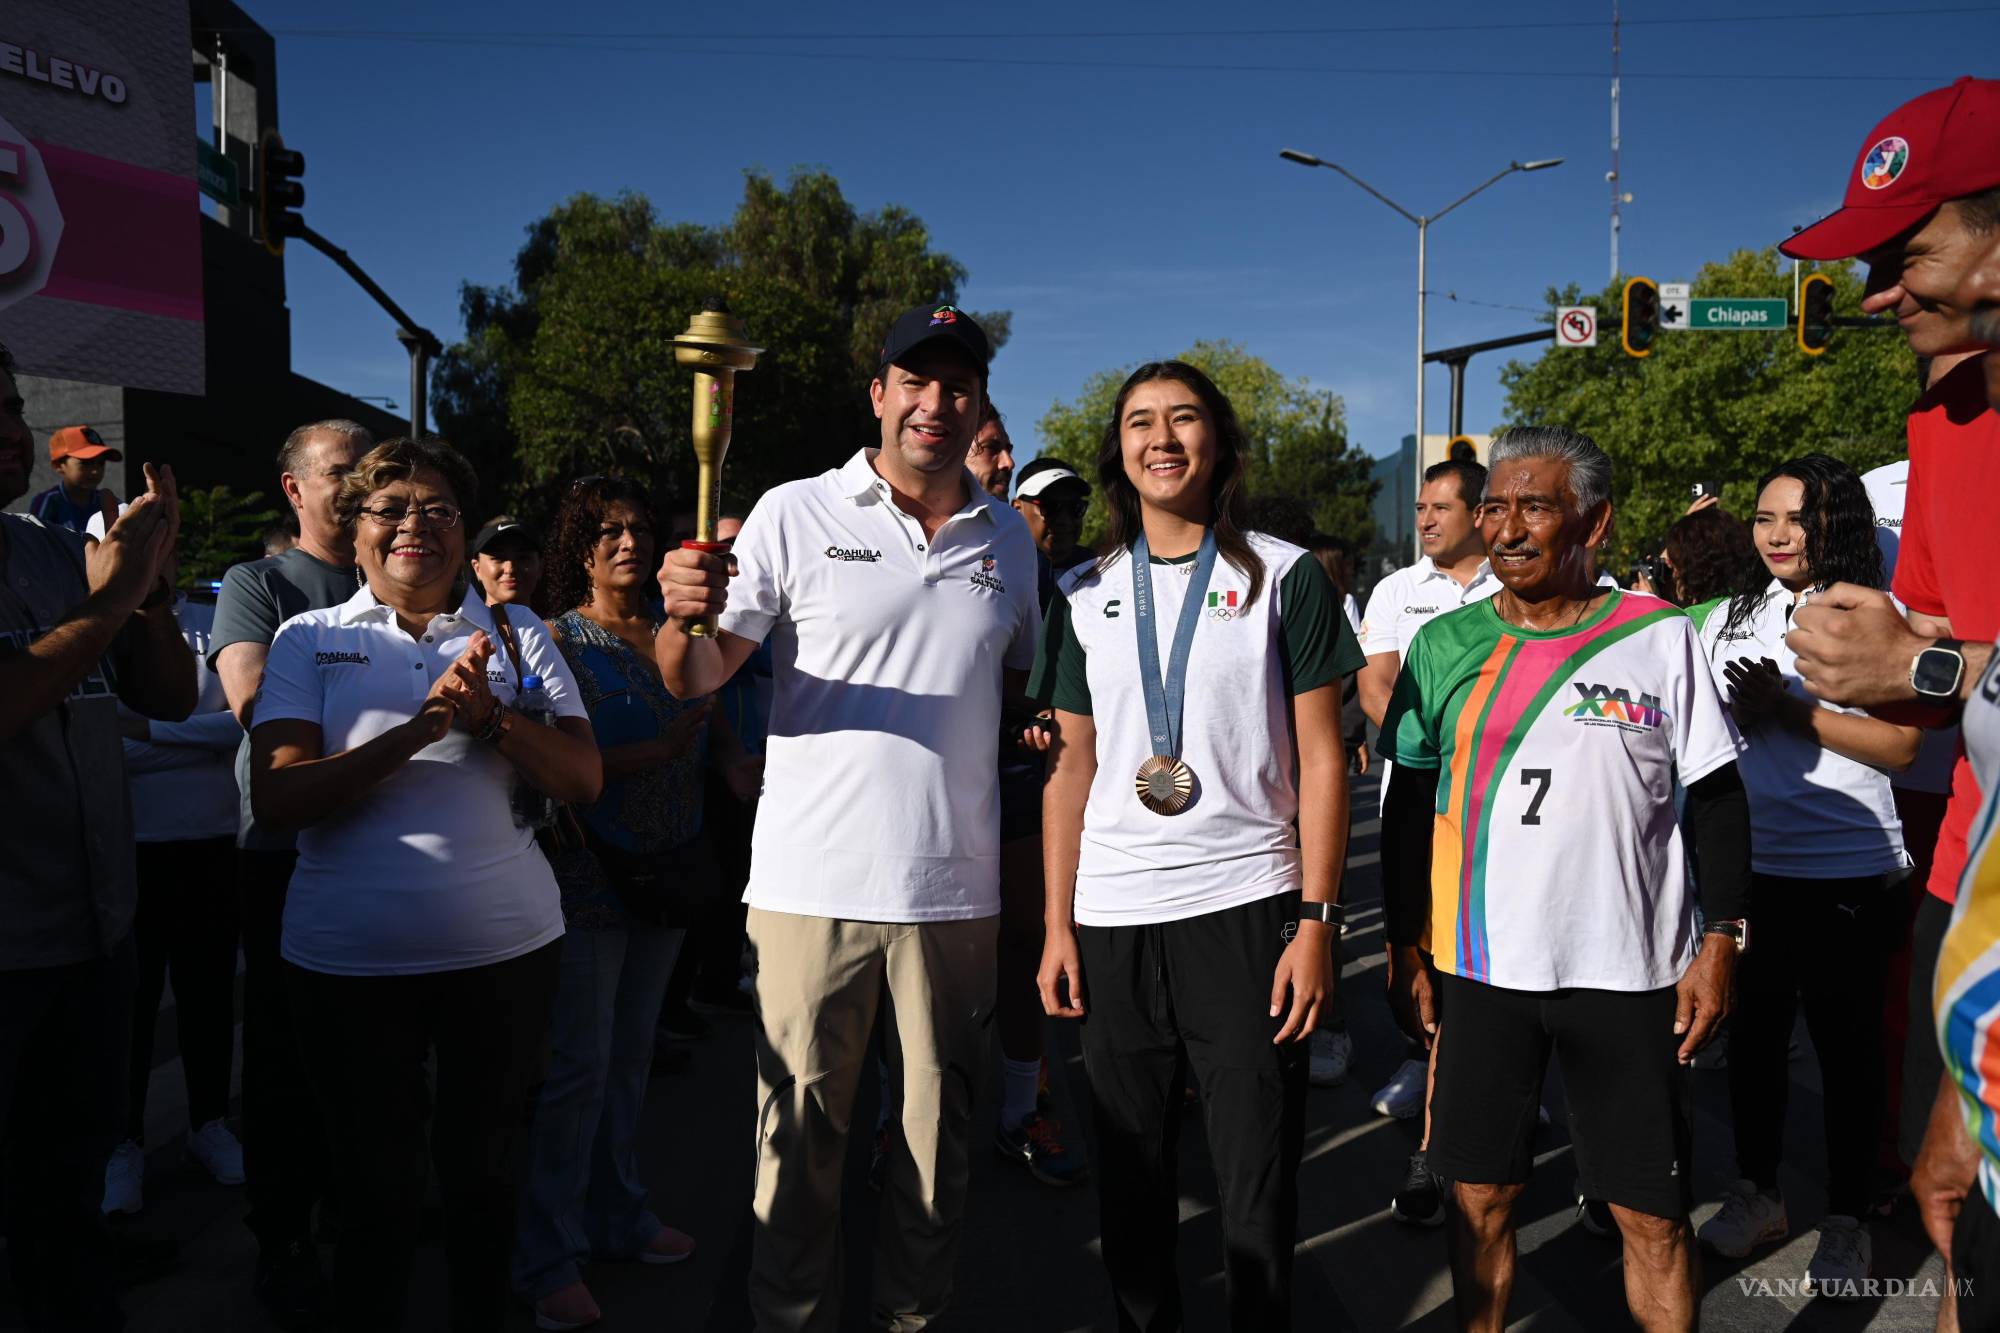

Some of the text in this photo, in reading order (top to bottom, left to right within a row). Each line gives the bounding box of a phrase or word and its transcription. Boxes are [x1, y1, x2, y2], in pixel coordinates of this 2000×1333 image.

[1707, 306, 1768, 326] Chiapas
[828, 546, 882, 558] COAHUILA
[970, 576, 1005, 593] SALTILLO
[1520, 768, 1552, 825] 7
